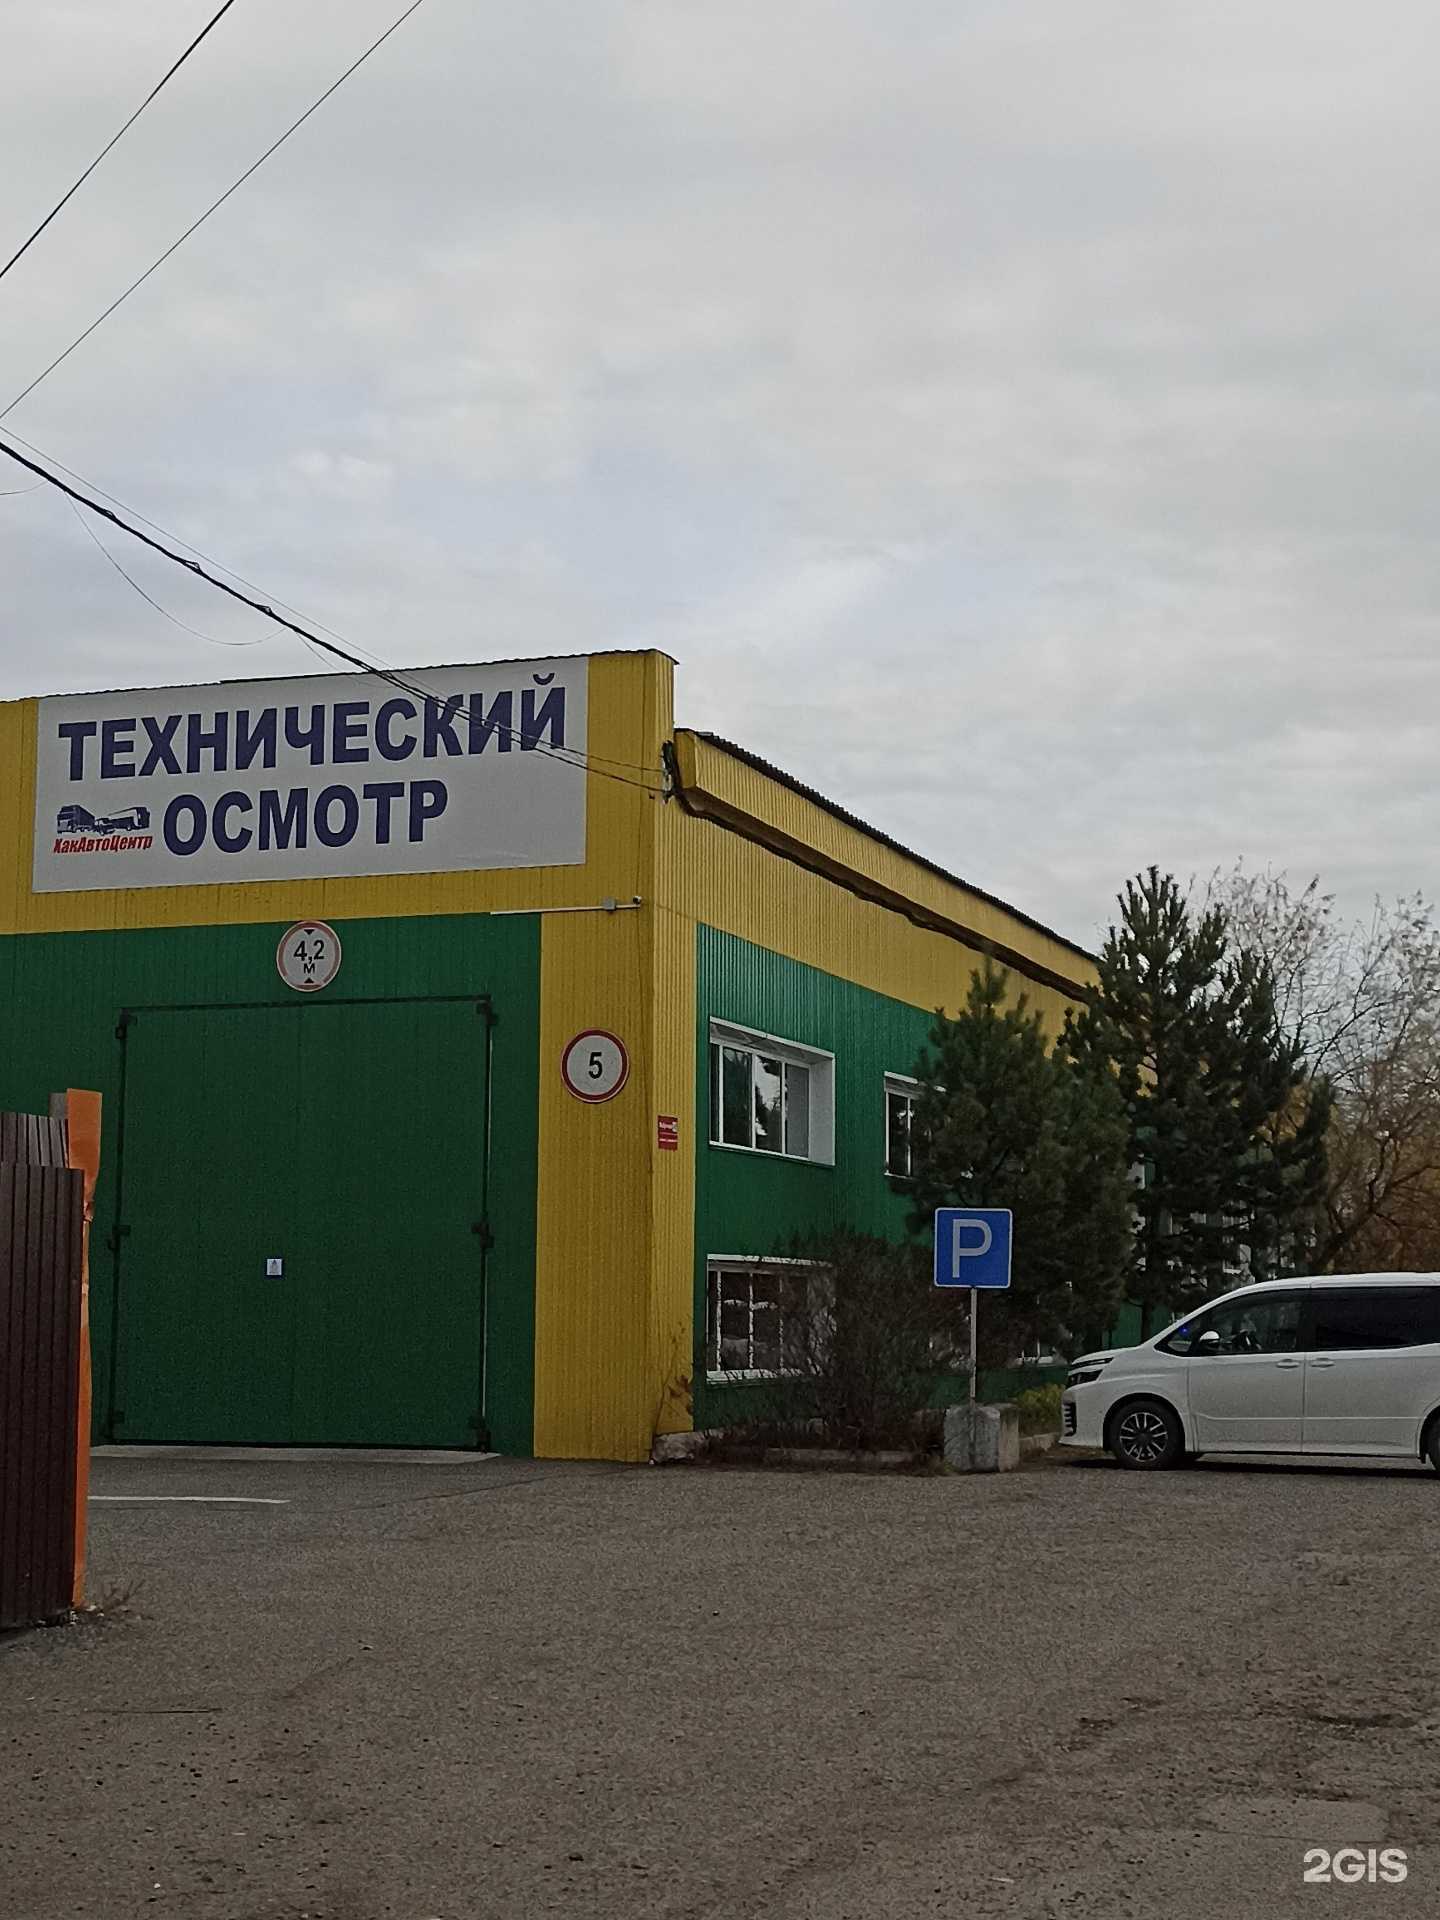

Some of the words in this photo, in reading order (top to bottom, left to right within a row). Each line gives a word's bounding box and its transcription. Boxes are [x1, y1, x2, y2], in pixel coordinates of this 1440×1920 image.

[58, 672, 566, 781] ТЕХНИЧЕСКИЙ
[163, 779, 448, 856] ОСМОТР
[293, 940, 324, 964] 4,2
[589, 1052, 602, 1079] 5
[952, 1219, 992, 1278] P
